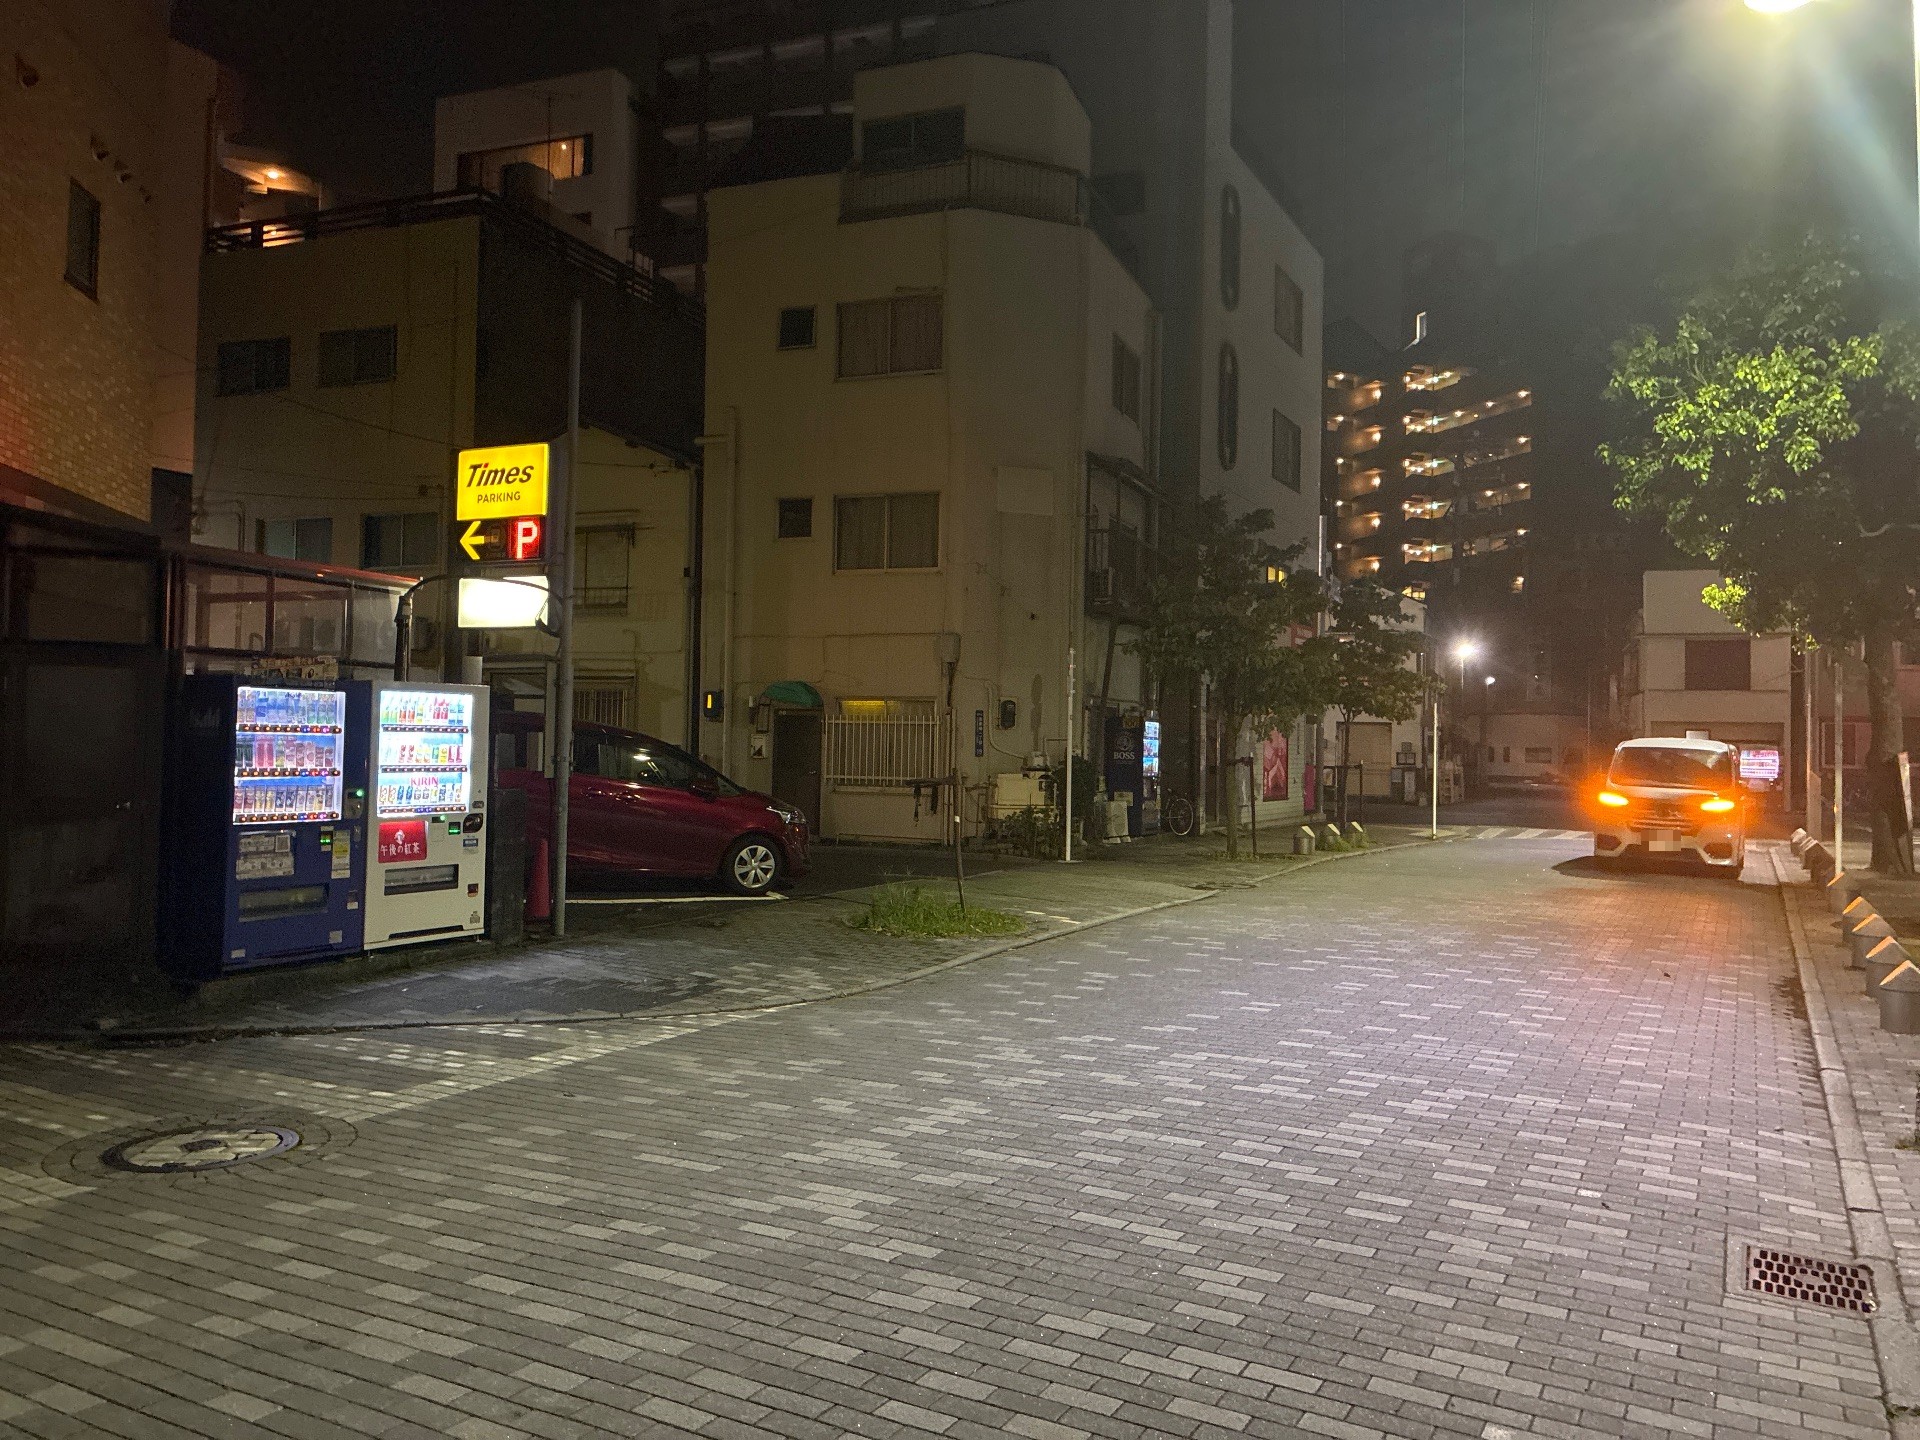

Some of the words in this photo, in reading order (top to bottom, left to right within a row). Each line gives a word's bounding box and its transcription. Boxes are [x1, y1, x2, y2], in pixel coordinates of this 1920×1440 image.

[466, 463, 535, 488] Times
[477, 491, 521, 504] PARKING
[516, 520, 538, 560] P
[1113, 751, 1135, 760] BOSS
[410, 776, 439, 787] KIRIN
[380, 842, 420, 857] 午後の紅茶
